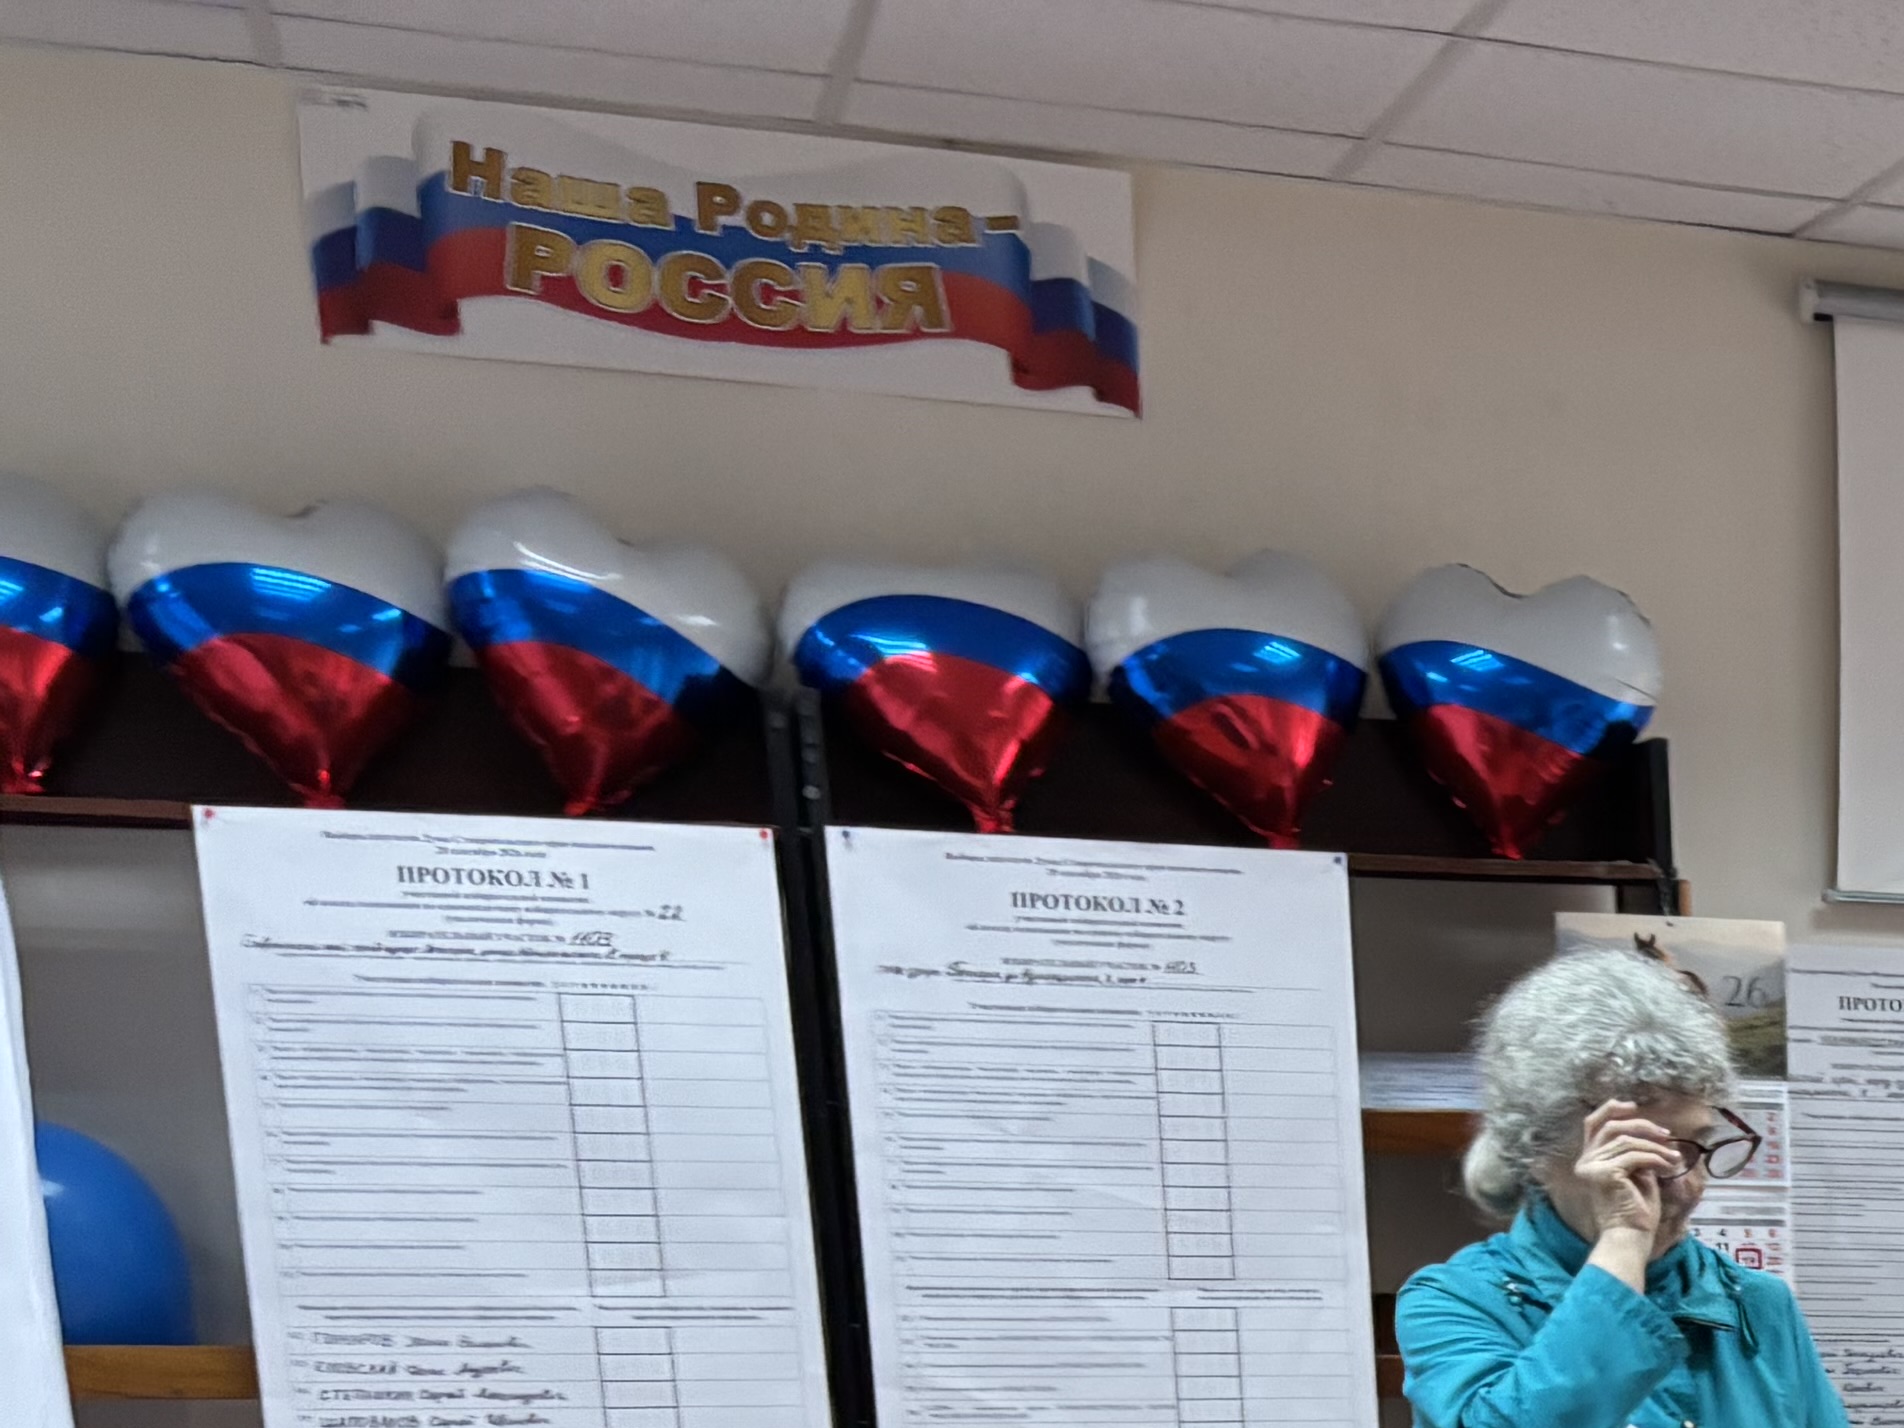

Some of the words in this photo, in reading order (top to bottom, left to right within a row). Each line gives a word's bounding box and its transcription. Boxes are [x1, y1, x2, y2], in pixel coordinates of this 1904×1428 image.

[449, 140, 673, 228] Наша
[503, 222, 955, 334] РОССИЯ
[396, 865, 542, 888] ПРОТОКОЛ
[1010, 891, 1141, 914] ПРОТОКОЛ
[1173, 899, 1186, 915] 2
